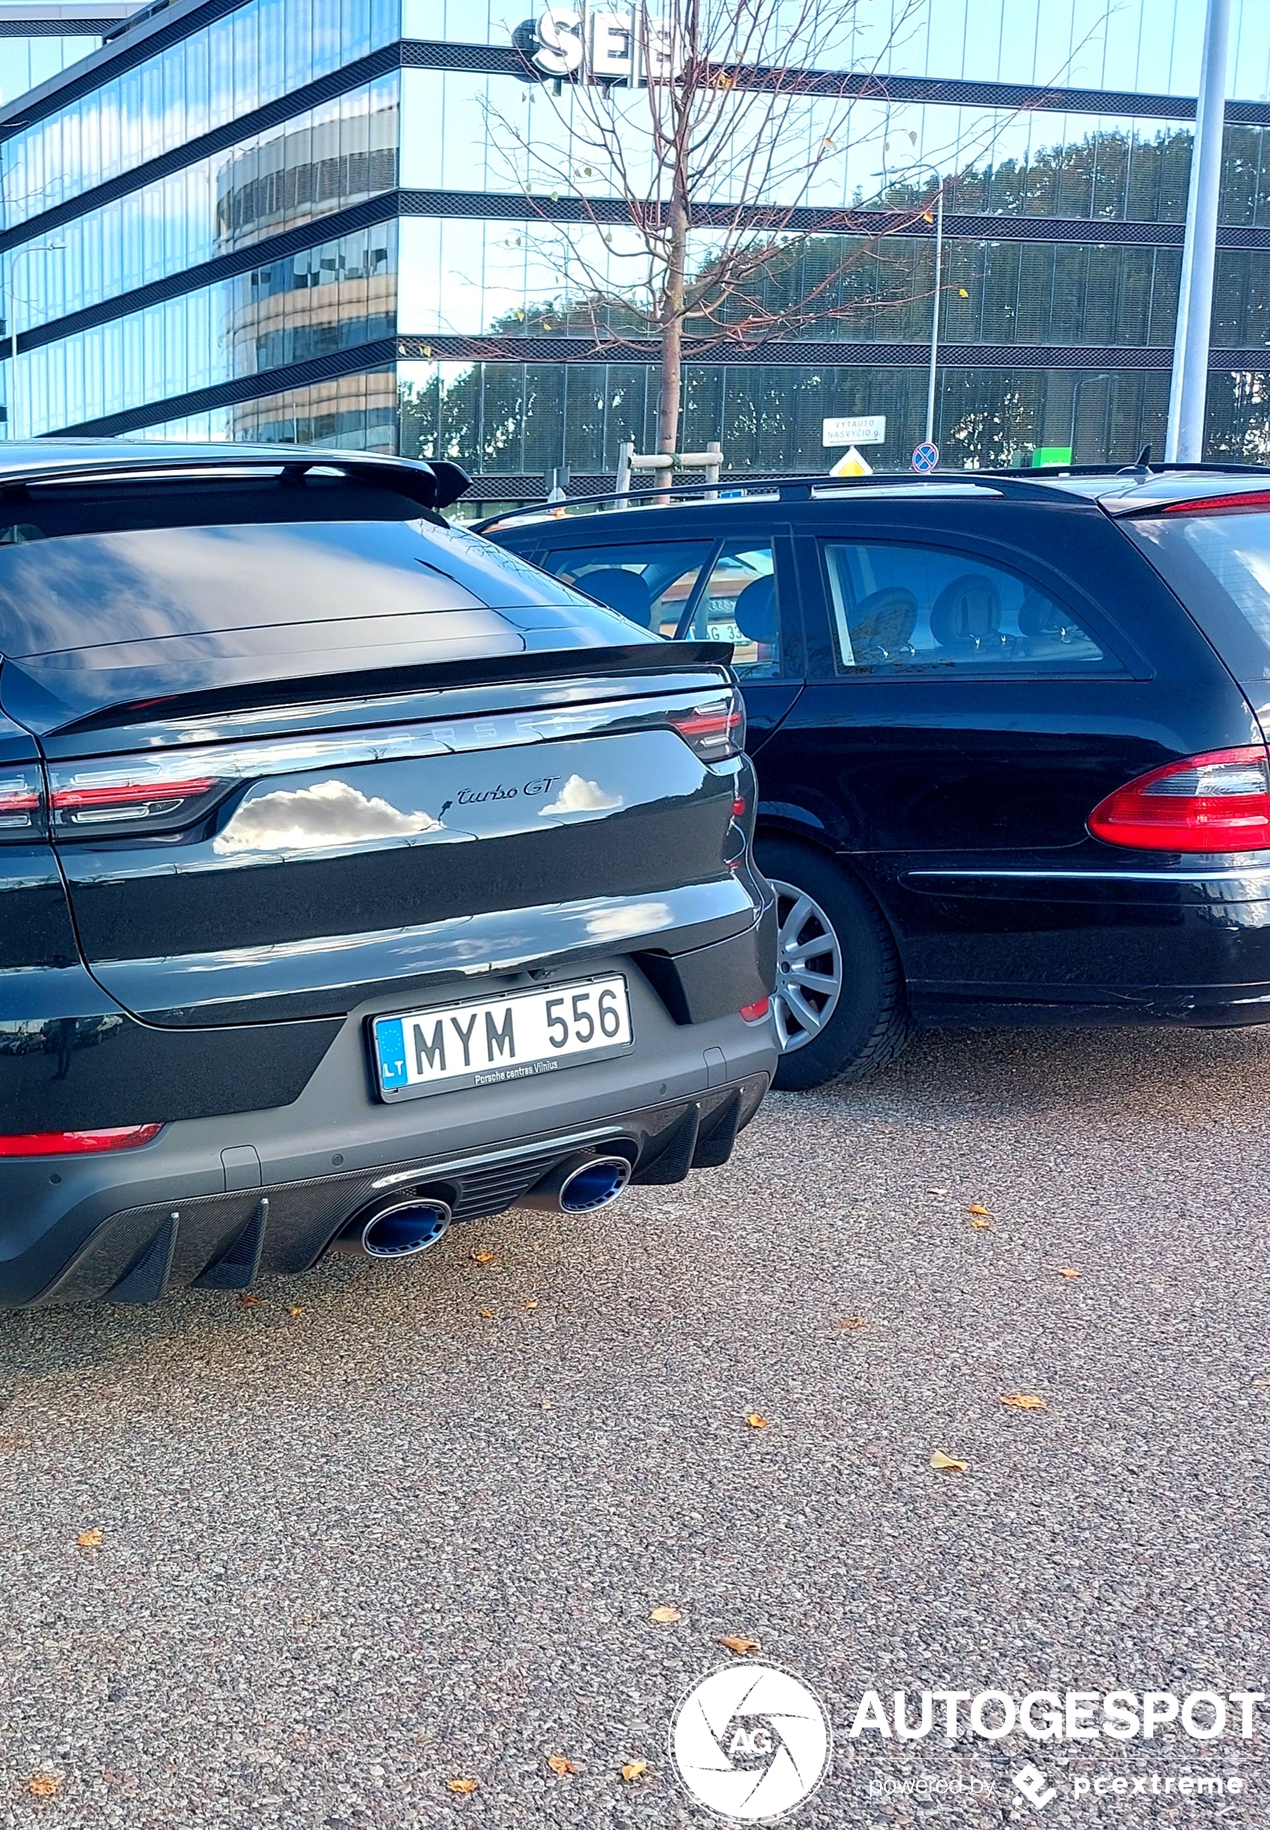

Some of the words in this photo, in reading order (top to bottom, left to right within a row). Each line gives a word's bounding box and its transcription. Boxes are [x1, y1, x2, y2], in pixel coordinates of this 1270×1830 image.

[835, 419, 875, 429] VYTAUTO
[523, 775, 561, 796] GT
[412, 1007, 516, 1075] MYM
[545, 988, 621, 1049] 556
[382, 1060, 405, 1080] LT
[474, 1071, 506, 1085] Porsche
[505, 1066, 533, 1080] centras
[533, 1060, 558, 1074] Vilnius
